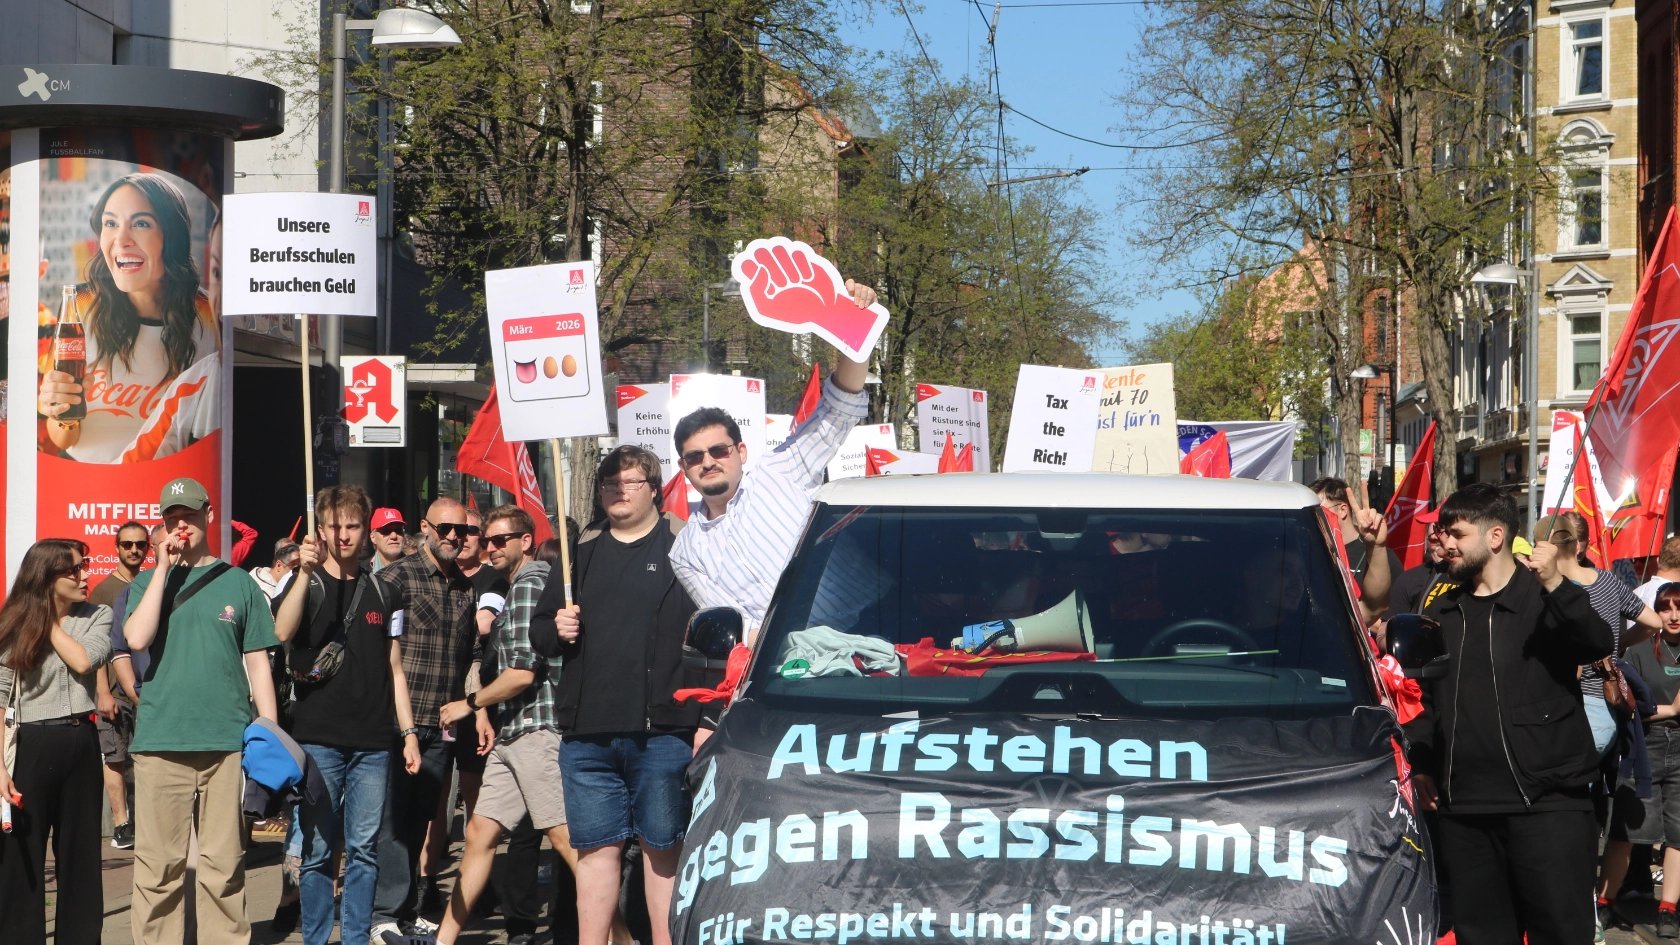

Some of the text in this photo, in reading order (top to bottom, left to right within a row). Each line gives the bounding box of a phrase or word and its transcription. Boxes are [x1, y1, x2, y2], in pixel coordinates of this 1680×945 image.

[50, 140, 69, 148] JULE
[50, 148, 104, 156] FUSSBALLFAN
[277, 217, 331, 234] Unsere
[249, 247, 356, 265] Berufsschulen
[249, 277, 356, 295] brauchen Geld
[509, 319, 581, 336] März 2026
[1046, 394, 1069, 410] Tax
[1130, 388, 1149, 406] 70
[931, 403, 959, 413] Mit der
[635, 412, 663, 421] Keine
[932, 416, 981, 428] Rüstung sind
[1097, 409, 1161, 431] ist für'n
[636, 427, 670, 436] Erhöhu
[933, 428, 944, 436] sie
[1043, 421, 1065, 437] the
[933, 440, 944, 448] für
[1033, 448, 1068, 466] Rich!
[171, 482, 185, 495] NY
[791, 659, 800, 669] 4
[767, 720, 1208, 781] Aufstehen
[676, 792, 1348, 916] gegen Rassismus
[698, 903, 1287, 945] Für Respekt und Solidarität!
